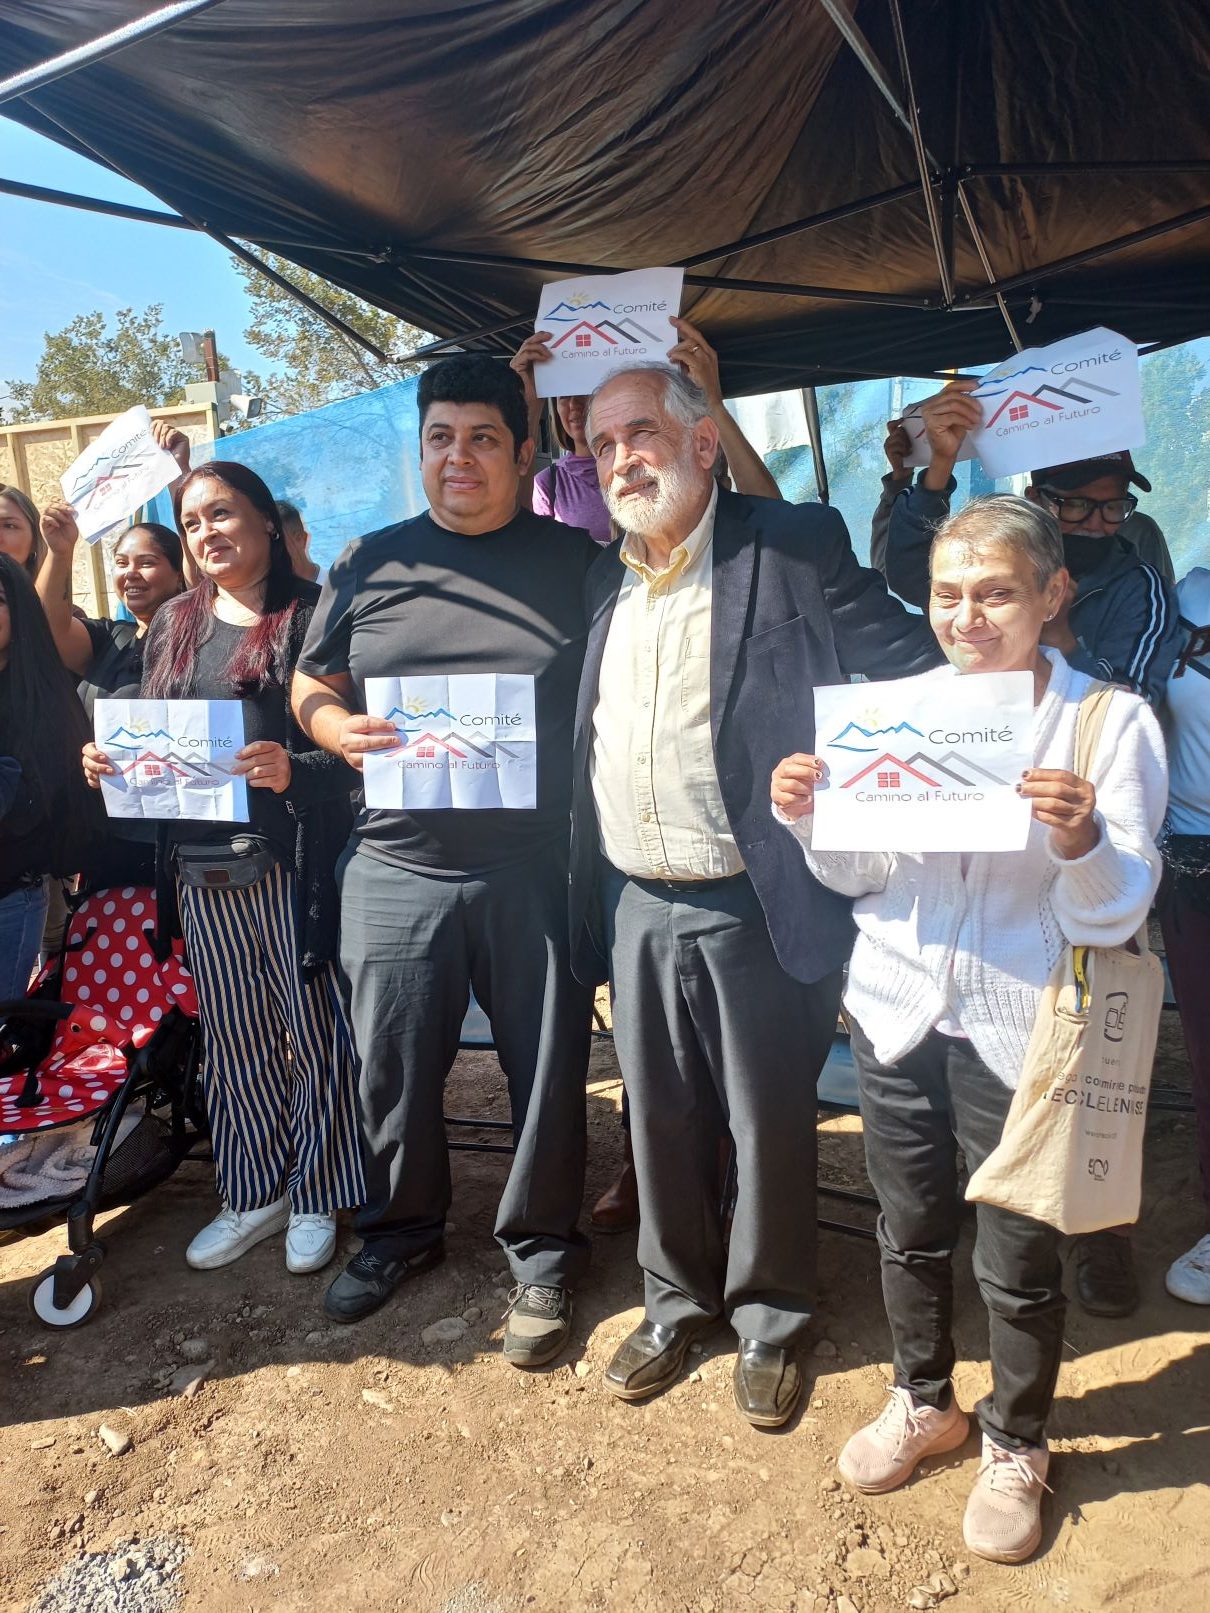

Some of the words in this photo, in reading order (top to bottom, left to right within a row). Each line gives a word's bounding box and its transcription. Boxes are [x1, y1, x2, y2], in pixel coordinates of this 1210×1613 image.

[613, 300, 667, 314] Comité
[561, 350, 600, 359] Camino
[602, 349, 611, 357] al
[613, 347, 647, 356] Futuro
[1051, 348, 1122, 375] Comité
[995, 420, 1040, 437] Camino
[1044, 414, 1054, 425] al
[1058, 406, 1101, 422] Futuro
[460, 713, 522, 727] Comité
[177, 736, 233, 748] Comité
[928, 725, 1013, 745] Comité
[397, 760, 444, 769] Camino
[448, 760, 458, 769] al
[461, 760, 501, 770] Futuro
[855, 791, 912, 802] Camino
[917, 791, 929, 801] al
[934, 790, 985, 801] Futuro
